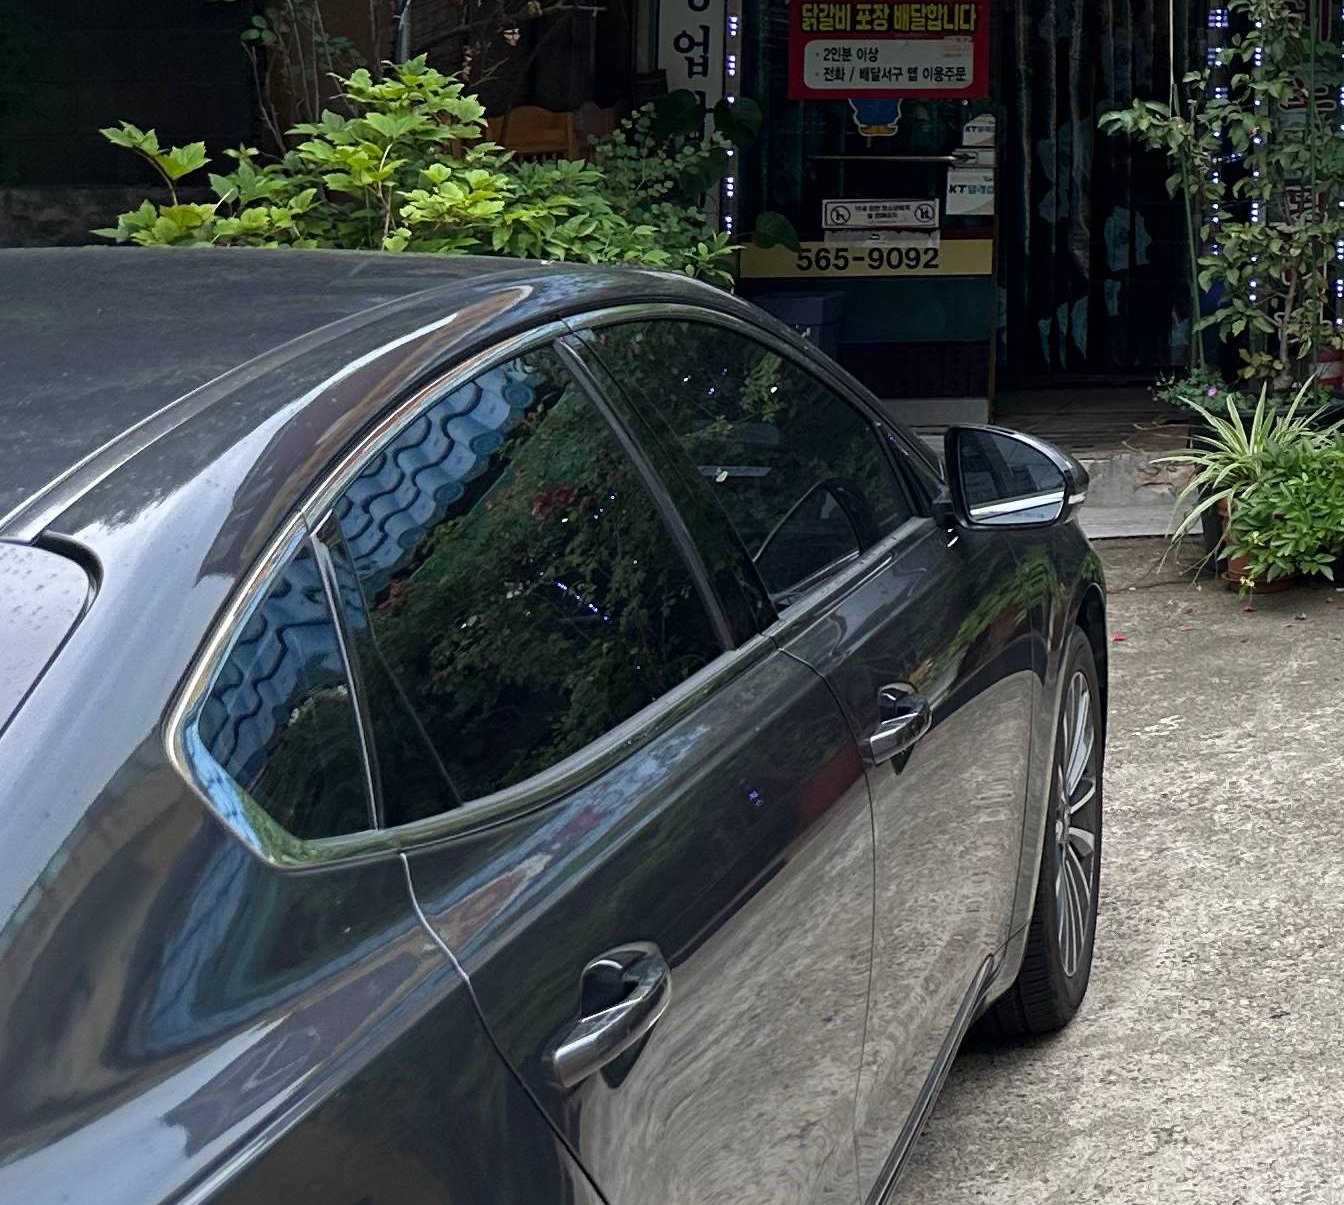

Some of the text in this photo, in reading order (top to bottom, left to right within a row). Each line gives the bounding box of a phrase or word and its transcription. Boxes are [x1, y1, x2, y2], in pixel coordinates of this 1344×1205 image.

[800, 2, 977, 31] 닭갈비 포장 배달합니다
[823, 47, 879, 62] 2인분 이상
[823, 66, 846, 82] 전화
[859, 66, 903, 82] 배달서구
[797, 247, 940, 271] 565-9092
